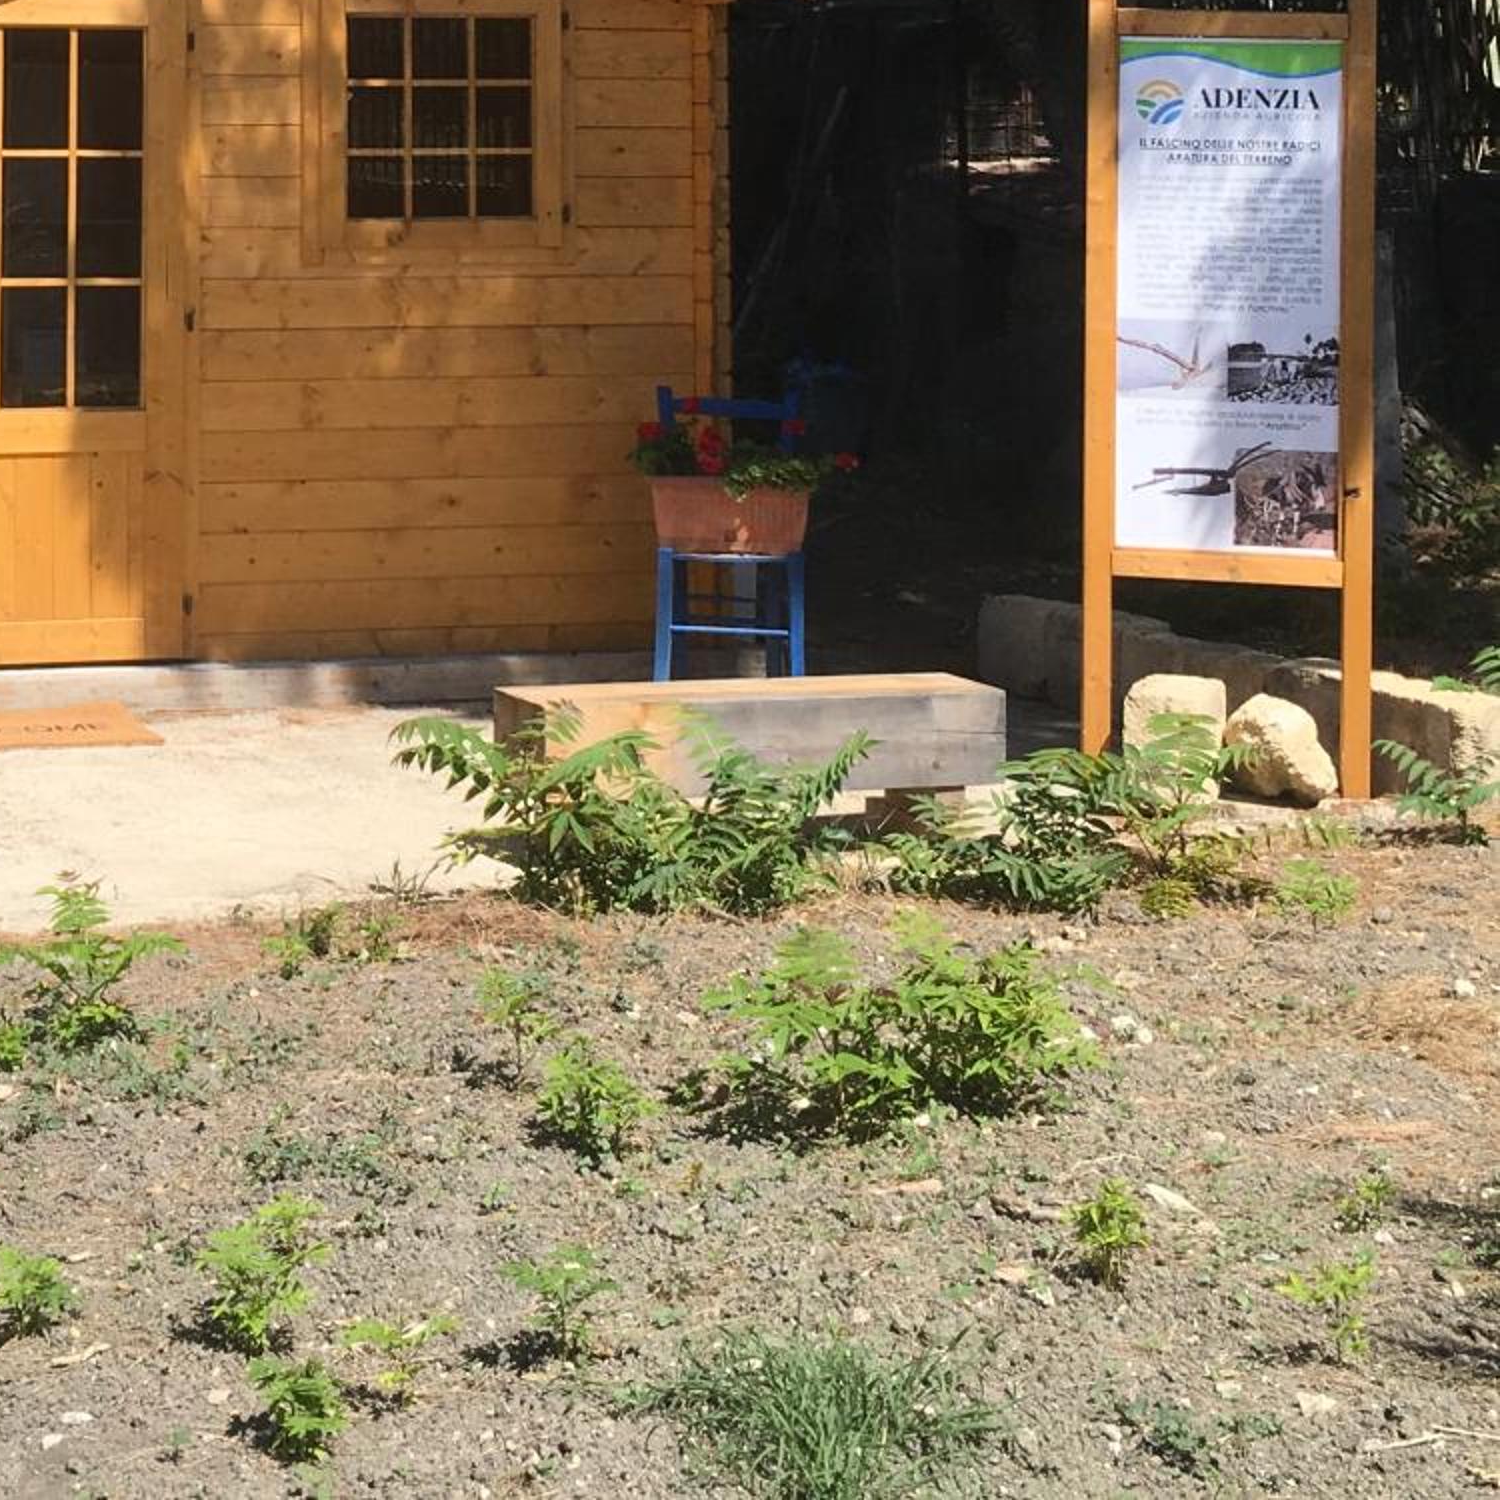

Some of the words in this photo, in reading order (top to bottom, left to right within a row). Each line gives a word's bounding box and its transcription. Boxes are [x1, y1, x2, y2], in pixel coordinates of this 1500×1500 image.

[1193, 88, 1320, 110] ADENZIA
[1150, 138, 1201, 149] FASCINO
[1203, 139, 1233, 149] DELLE
[1237, 140, 1278, 150] NOSTRE
